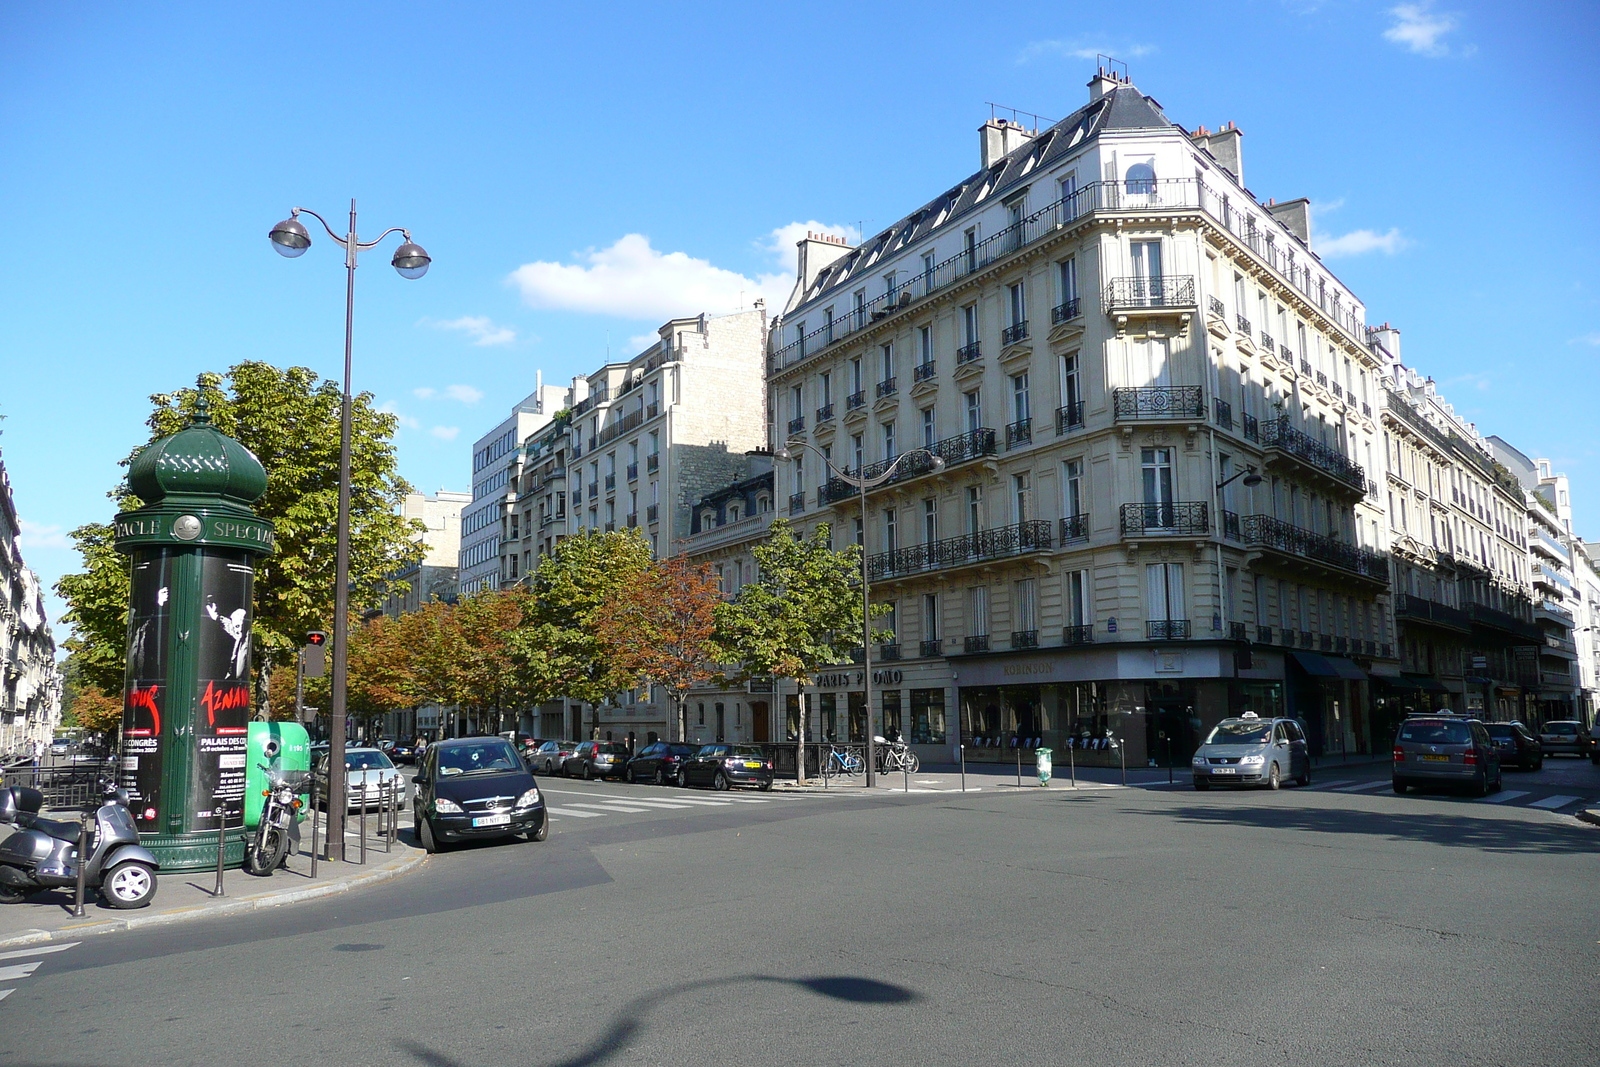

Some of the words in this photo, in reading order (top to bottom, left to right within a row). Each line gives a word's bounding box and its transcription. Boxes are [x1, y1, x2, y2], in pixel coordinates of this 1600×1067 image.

[1003, 662, 1053, 676] ROBINSON
[816, 673, 849, 688] PARIS
[856, 669, 902, 685] POMO
[127, 738, 158, 747] CONGRÈS
[201, 738, 228, 746] PALAIS
[228, 737, 239, 745] DES
